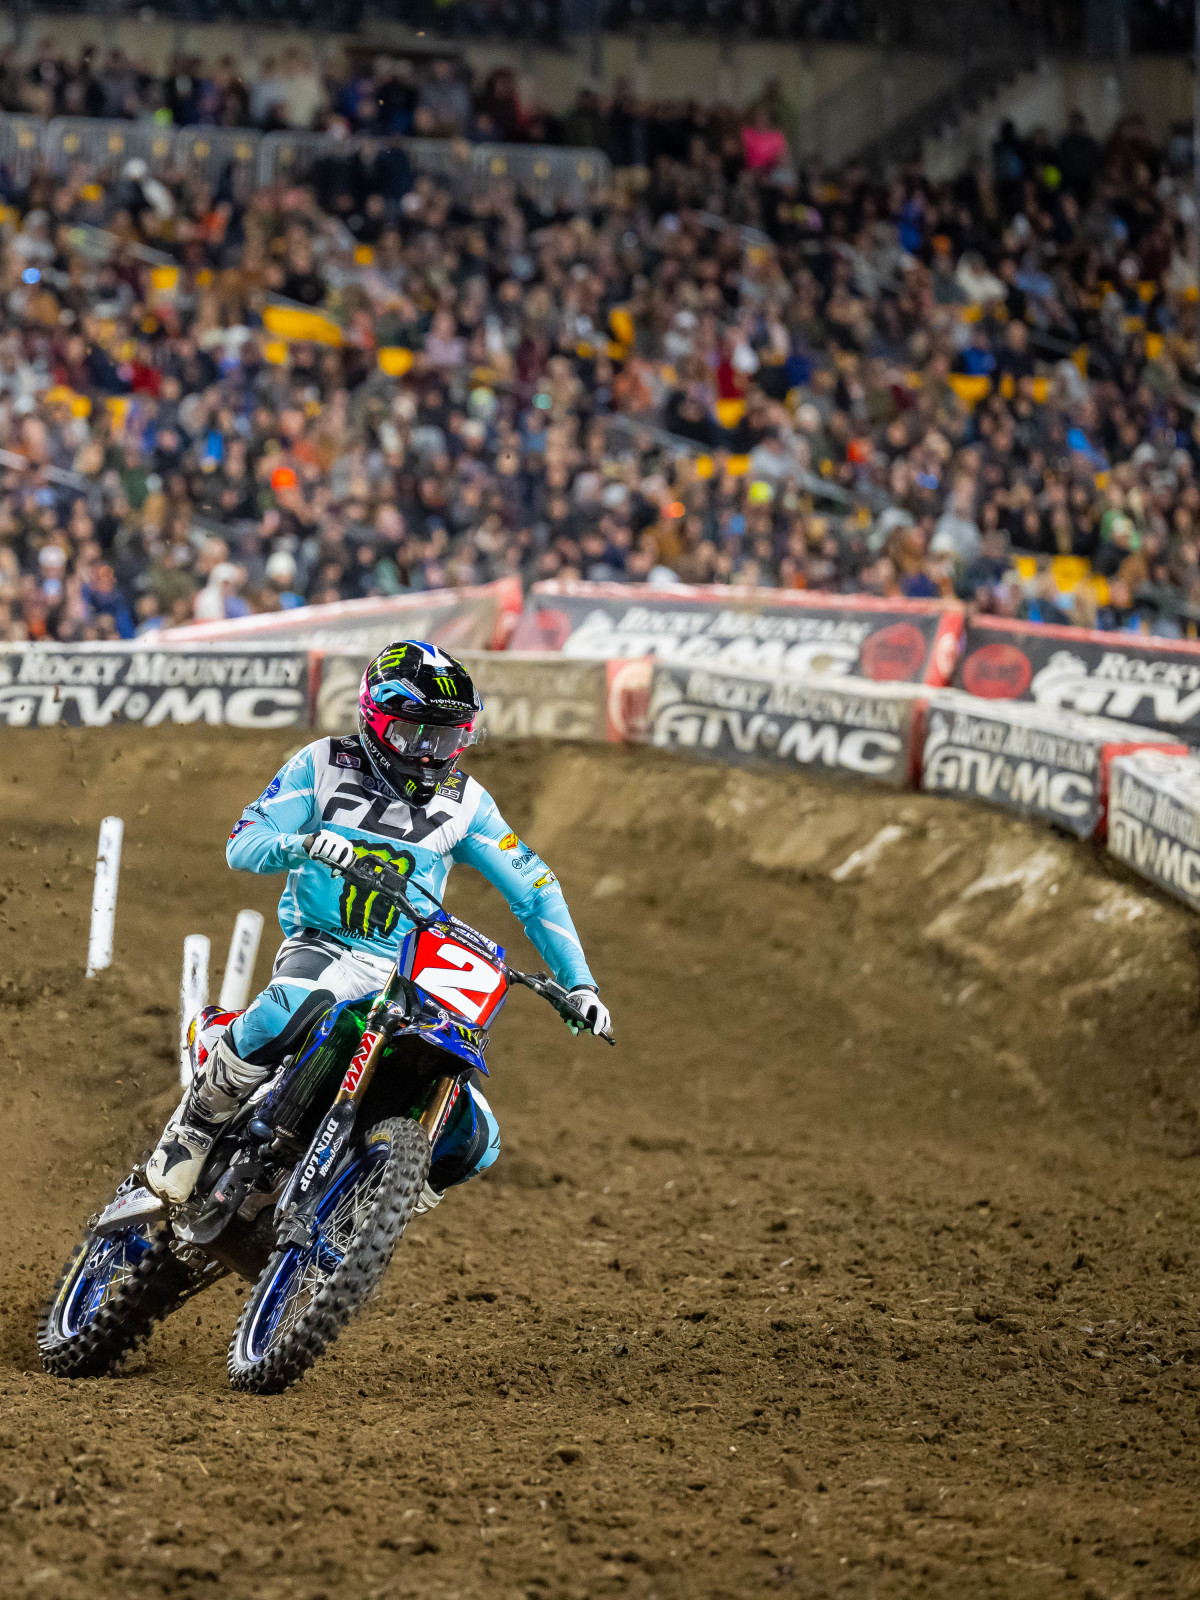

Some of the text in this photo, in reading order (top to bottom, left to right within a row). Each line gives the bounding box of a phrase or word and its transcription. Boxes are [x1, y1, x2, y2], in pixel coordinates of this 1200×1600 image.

[18, 652, 306, 687] ROCKY MOUNTAIN
[429, 698, 473, 710] MONSTER
[322, 782, 454, 844] FLY
[413, 942, 502, 1025] 2
[340, 1031, 379, 1094] KYB
[300, 1117, 340, 1192] DUNLOP
